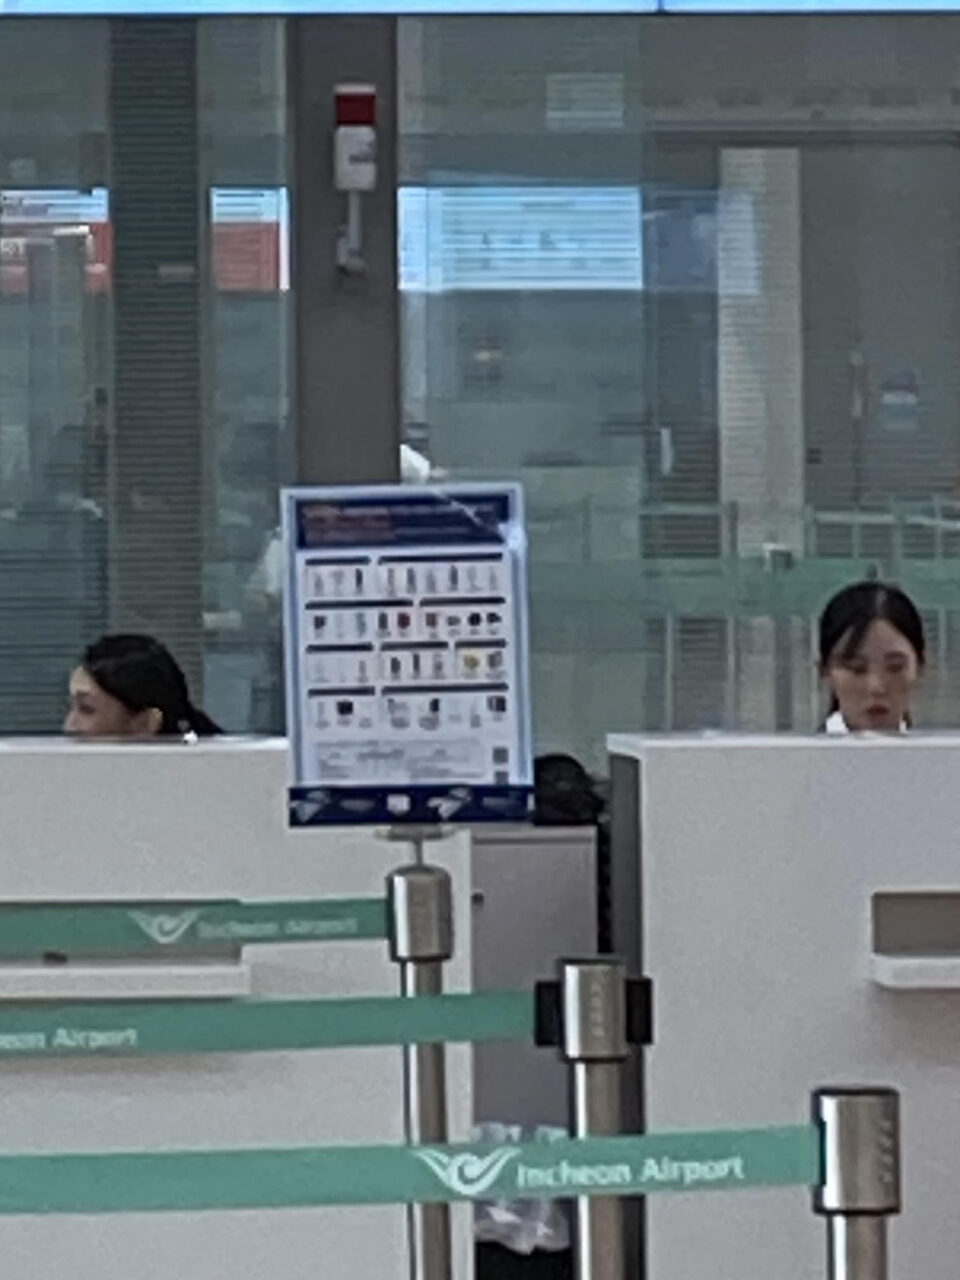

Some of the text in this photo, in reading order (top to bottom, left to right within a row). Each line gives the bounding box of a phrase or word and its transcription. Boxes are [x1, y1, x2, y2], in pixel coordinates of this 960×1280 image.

[53, 1024, 137, 1050] Airport
[516, 1155, 745, 1188] Incheon Airport
